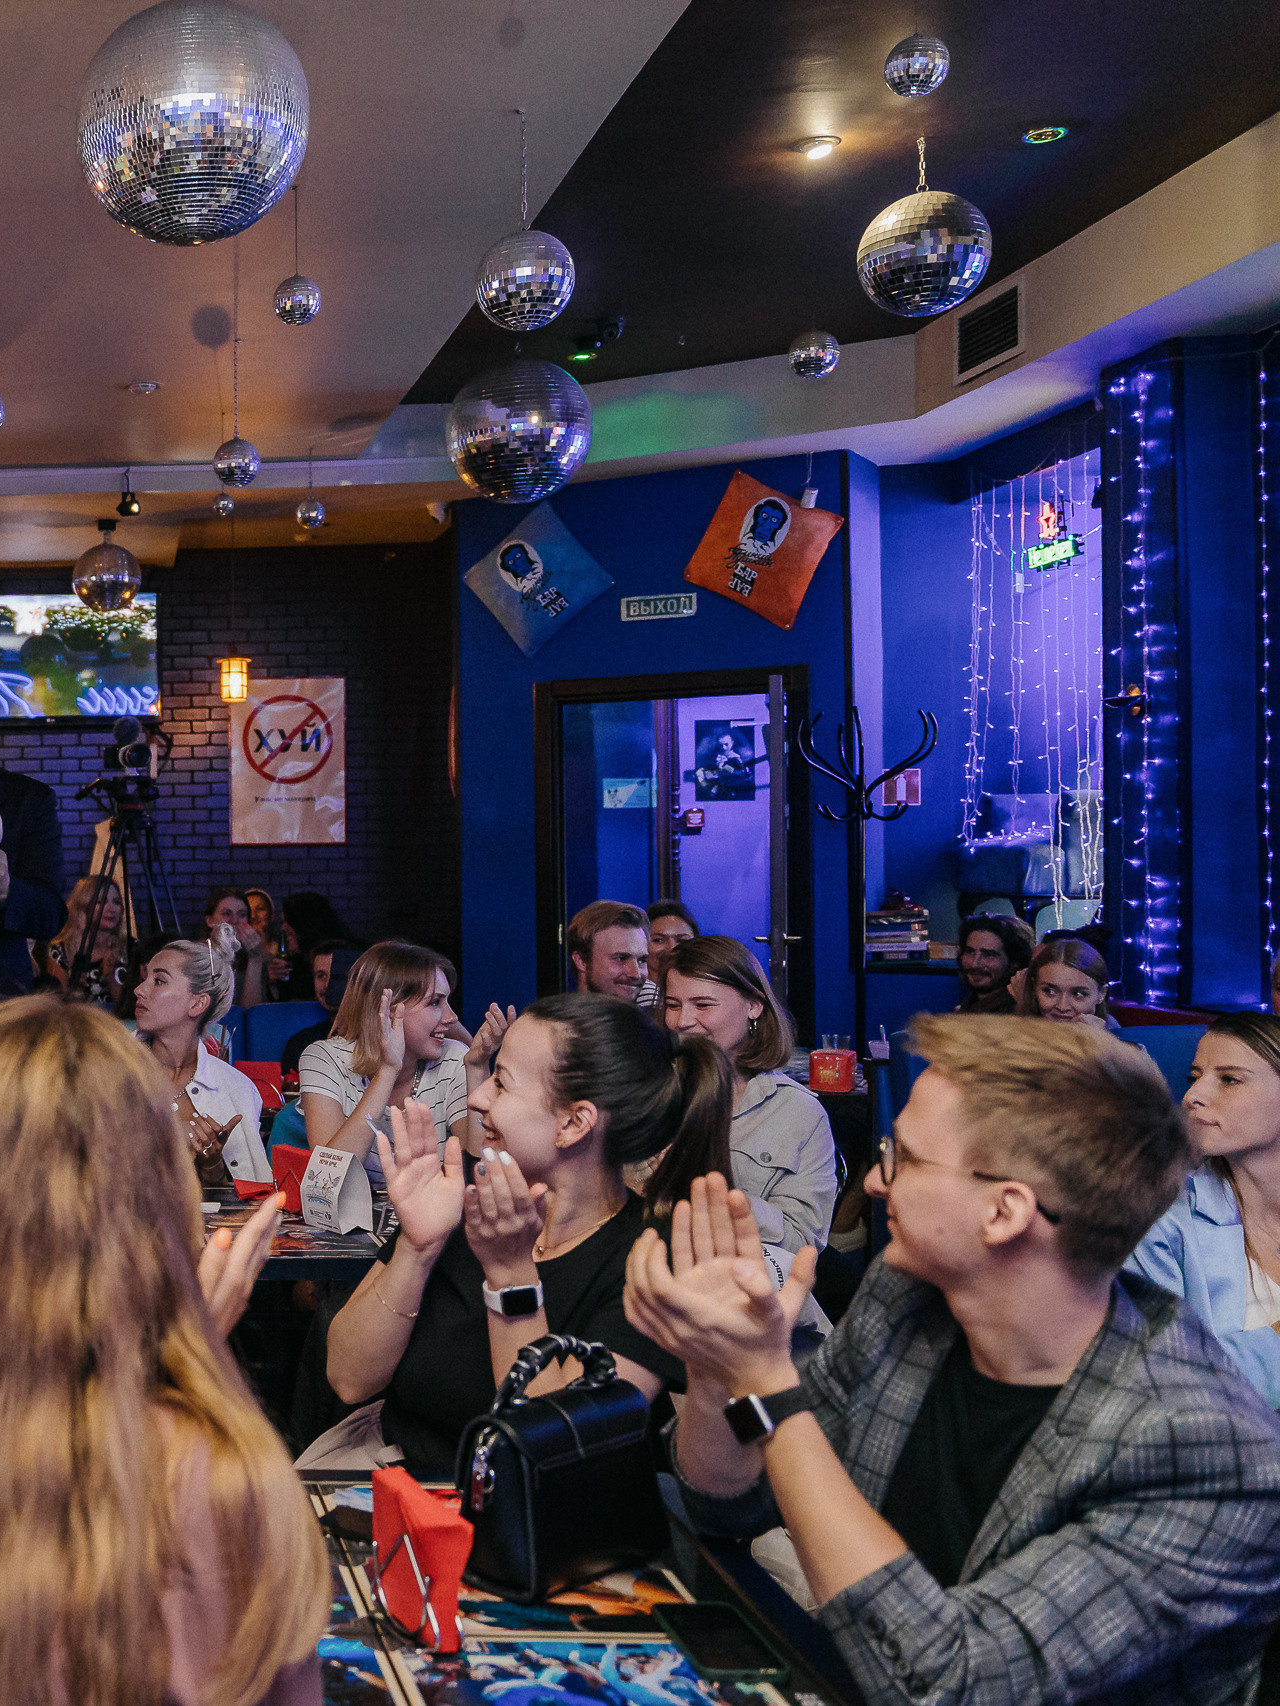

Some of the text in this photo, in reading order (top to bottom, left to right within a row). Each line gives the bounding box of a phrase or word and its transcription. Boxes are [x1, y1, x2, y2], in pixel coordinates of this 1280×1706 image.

[734, 561, 759, 581] БАР
[536, 586, 557, 607] БАР
[629, 598, 693, 616] ВЫХОД
[254, 721, 321, 753] ХУЙ
